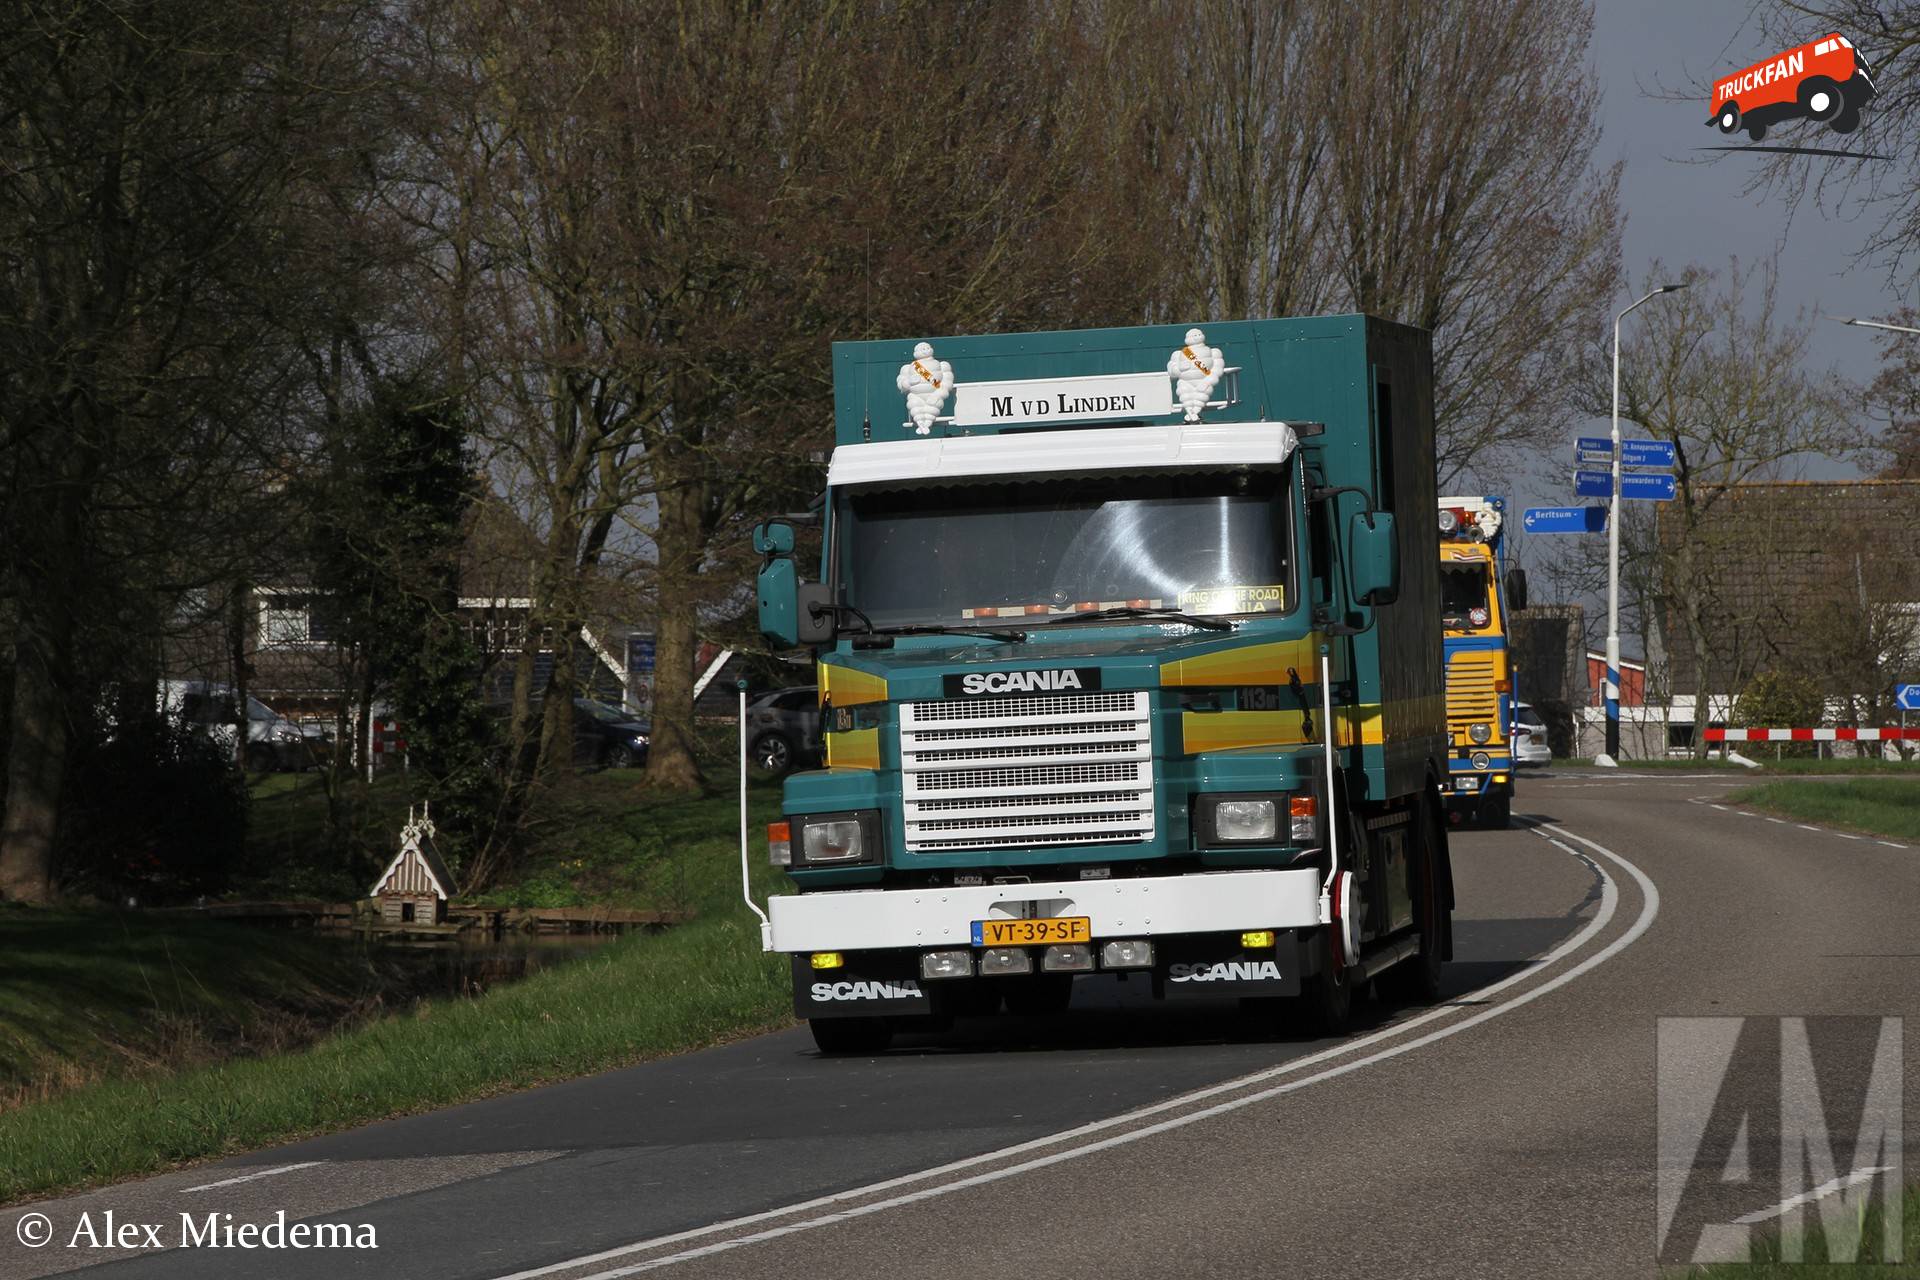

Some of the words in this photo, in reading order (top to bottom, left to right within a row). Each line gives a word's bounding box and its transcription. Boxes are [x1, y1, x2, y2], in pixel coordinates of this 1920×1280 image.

[990, 396, 1013, 417] M
[1249, 588, 1280, 601] ROAD
[962, 669, 1083, 695] SCANIA
[991, 921, 1081, 942] VT-39-SF
[1168, 961, 1282, 983] SCANIA
[810, 980, 923, 1002] SCANIA
